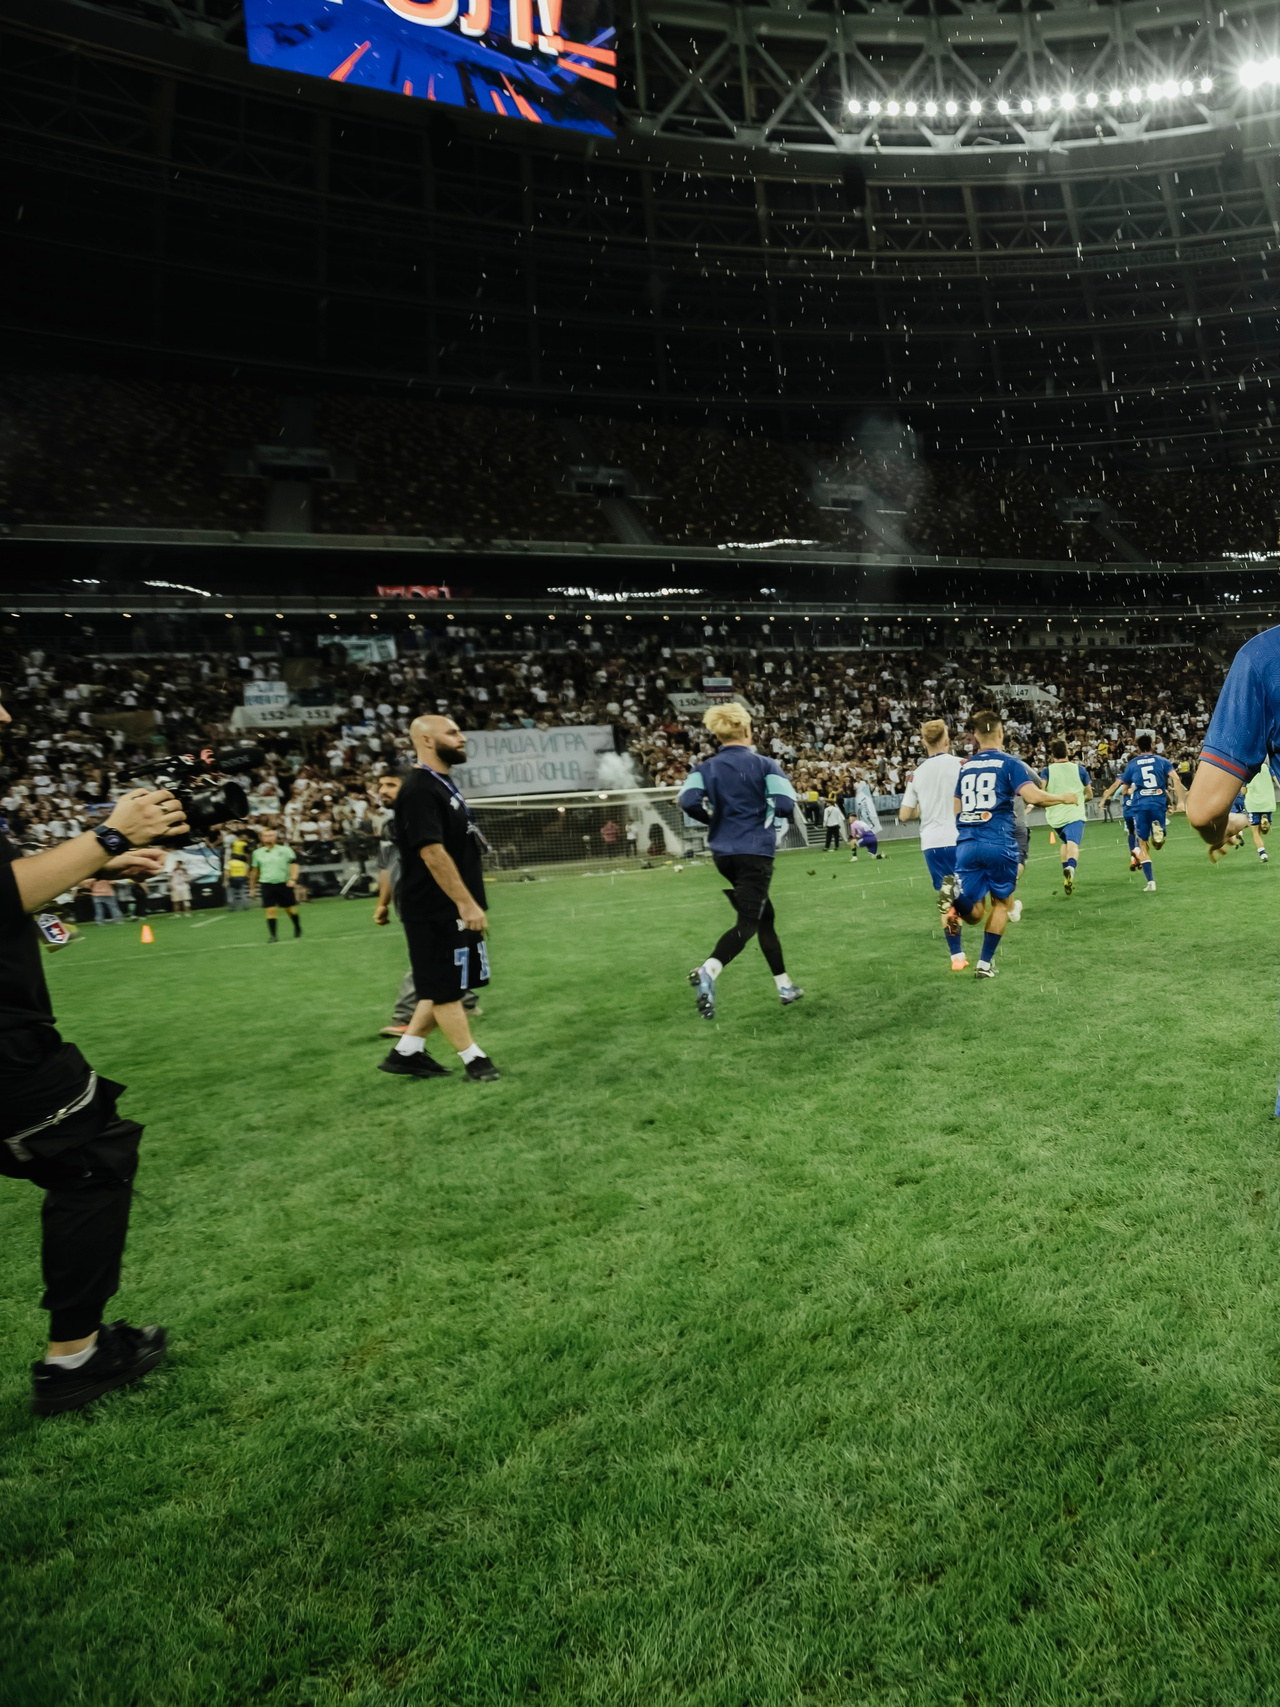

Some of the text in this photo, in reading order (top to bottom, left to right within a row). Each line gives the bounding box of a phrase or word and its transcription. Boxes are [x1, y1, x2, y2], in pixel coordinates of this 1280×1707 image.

[484, 735, 536, 757] НАША
[540, 732, 588, 753] ИГРА
[1140, 765, 1158, 788] 5
[960, 772, 997, 811] 88
